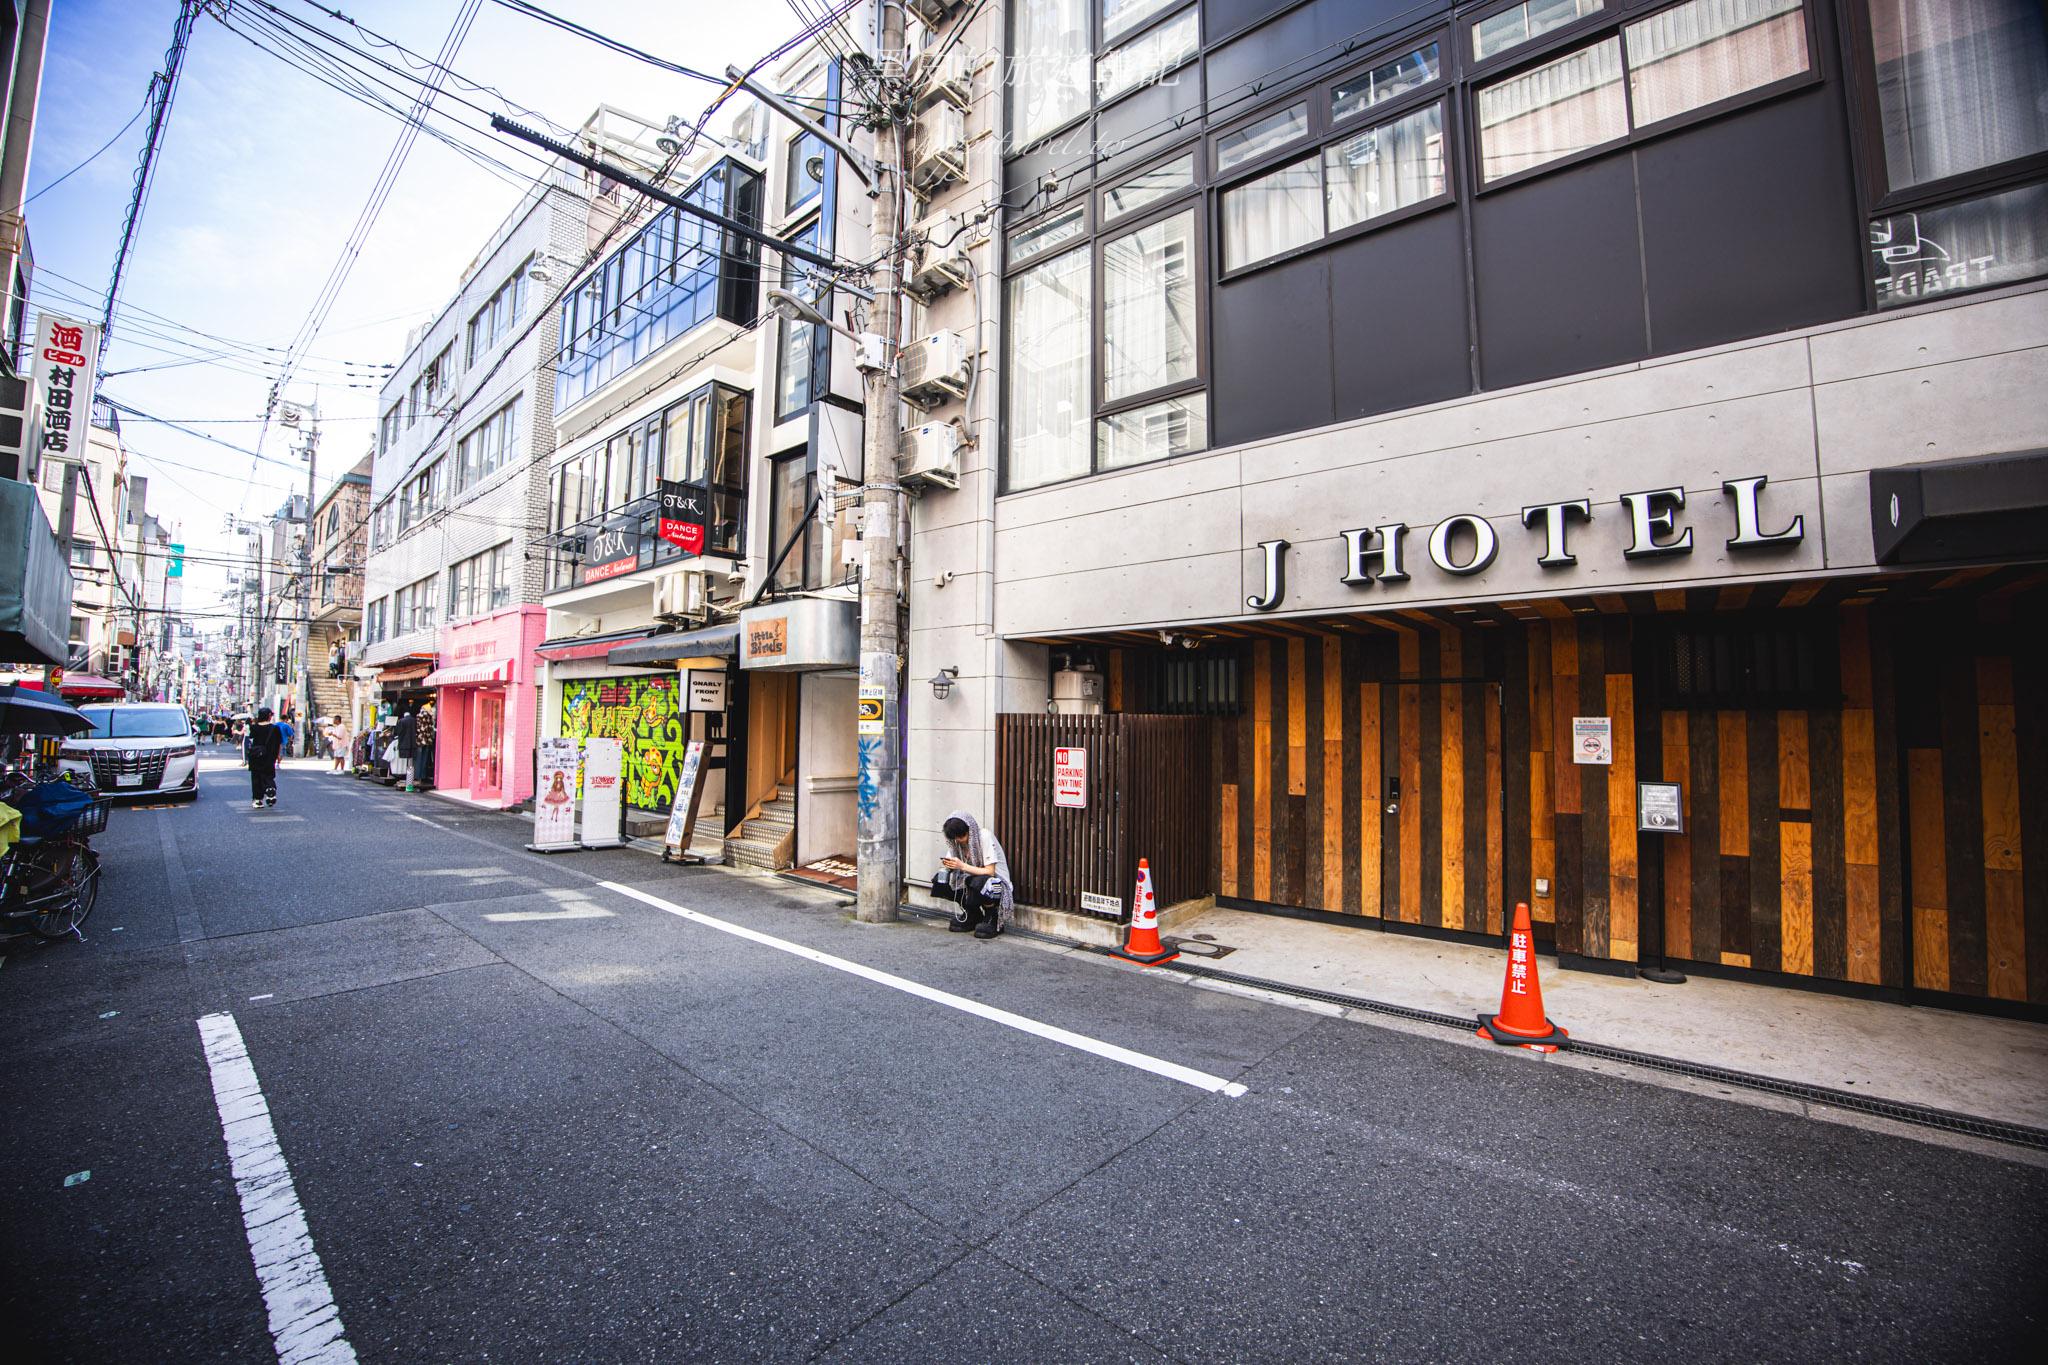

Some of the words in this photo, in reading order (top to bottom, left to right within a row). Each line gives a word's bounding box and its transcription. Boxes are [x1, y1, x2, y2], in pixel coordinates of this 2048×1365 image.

[49, 321, 84, 352] 酒
[48, 350, 83, 366] ビール
[43, 364, 77, 453] 村田酒店
[666, 522, 698, 535] DANCE
[1245, 539, 1291, 612] J
[1339, 474, 1804, 587] HOTEL
[585, 565, 610, 582] DANCE
[692, 680, 722, 688] GNARLY
[1056, 751, 1068, 764] NO
[1057, 767, 1084, 778] PARKING
[1057, 779, 1068, 787] ANY
[1069, 779, 1082, 789] TIME
[1511, 933, 1527, 995] 駐車禁止
